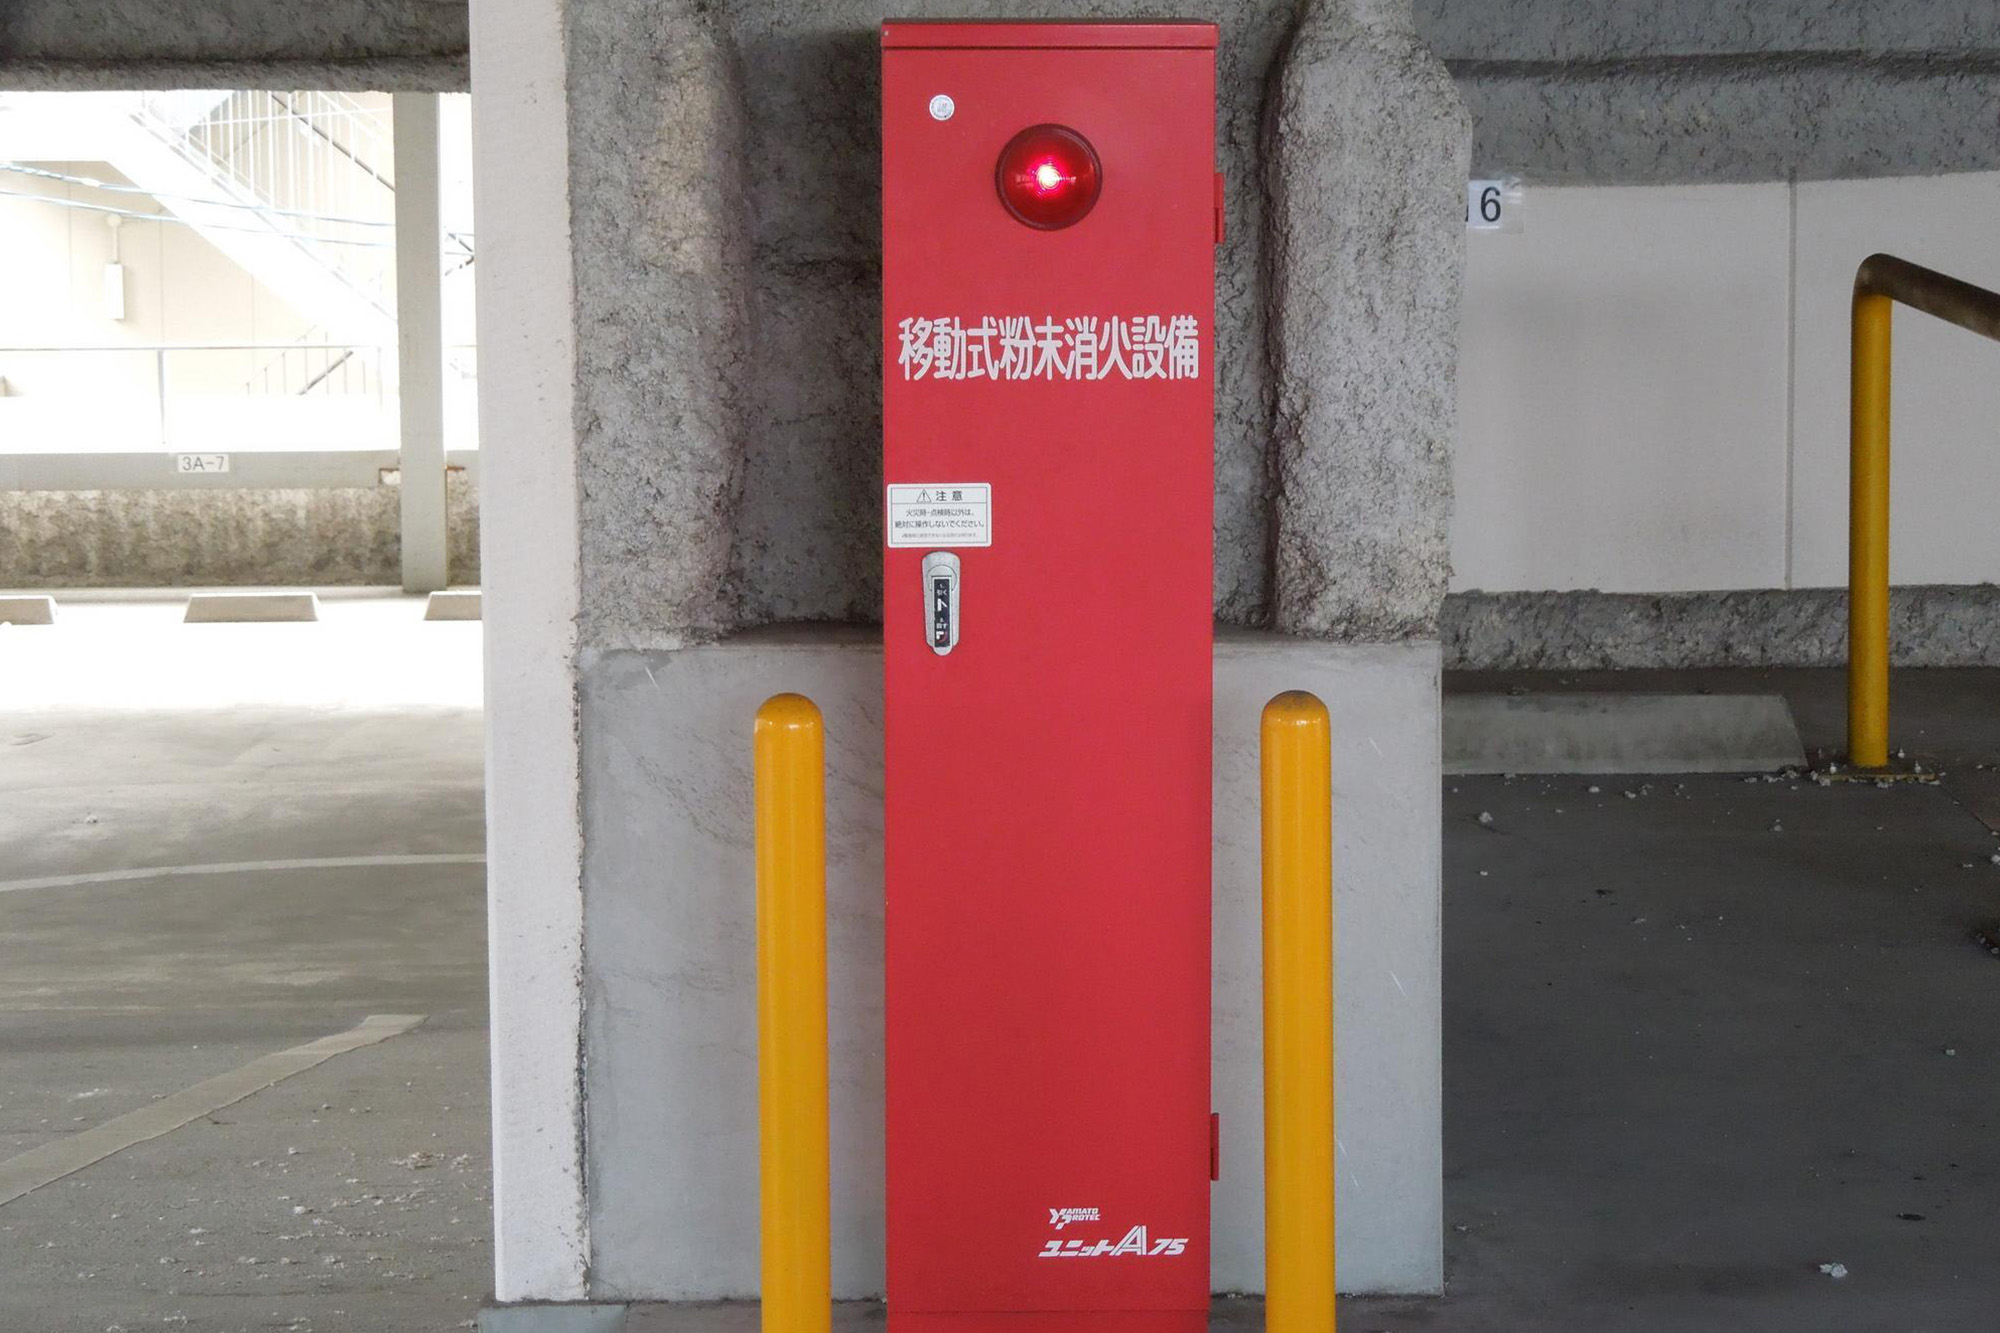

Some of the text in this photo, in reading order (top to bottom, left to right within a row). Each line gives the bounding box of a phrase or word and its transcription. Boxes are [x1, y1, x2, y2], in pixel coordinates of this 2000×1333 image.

[1465, 186, 1501, 222] 6
[898, 315, 1199, 380] 移動式粉末消火設備
[182, 456, 225, 471] 3A-7
[935, 490, 963, 501] 注意
